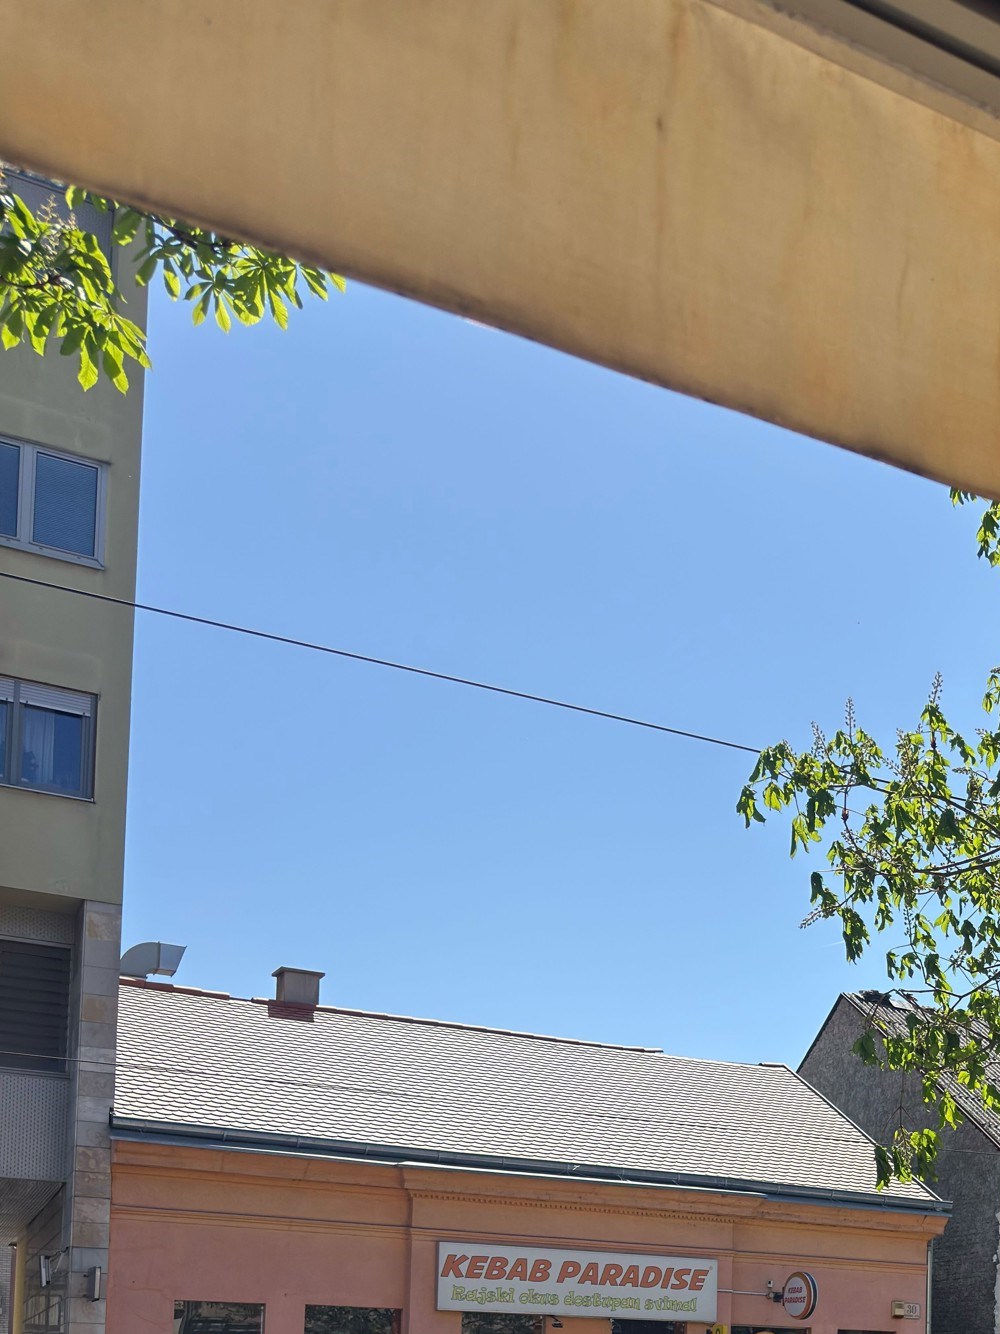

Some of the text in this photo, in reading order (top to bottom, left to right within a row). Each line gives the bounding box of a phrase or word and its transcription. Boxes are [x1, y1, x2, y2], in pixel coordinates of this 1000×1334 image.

[440, 1254, 710, 1292] KEBAB PARADISE
[788, 1286, 803, 1294] KEBAB
[450, 1285, 698, 1313] Rajski okus dostupan svima!
[784, 1296, 806, 1304] PARADISE
[906, 1304, 917, 1315] 30
